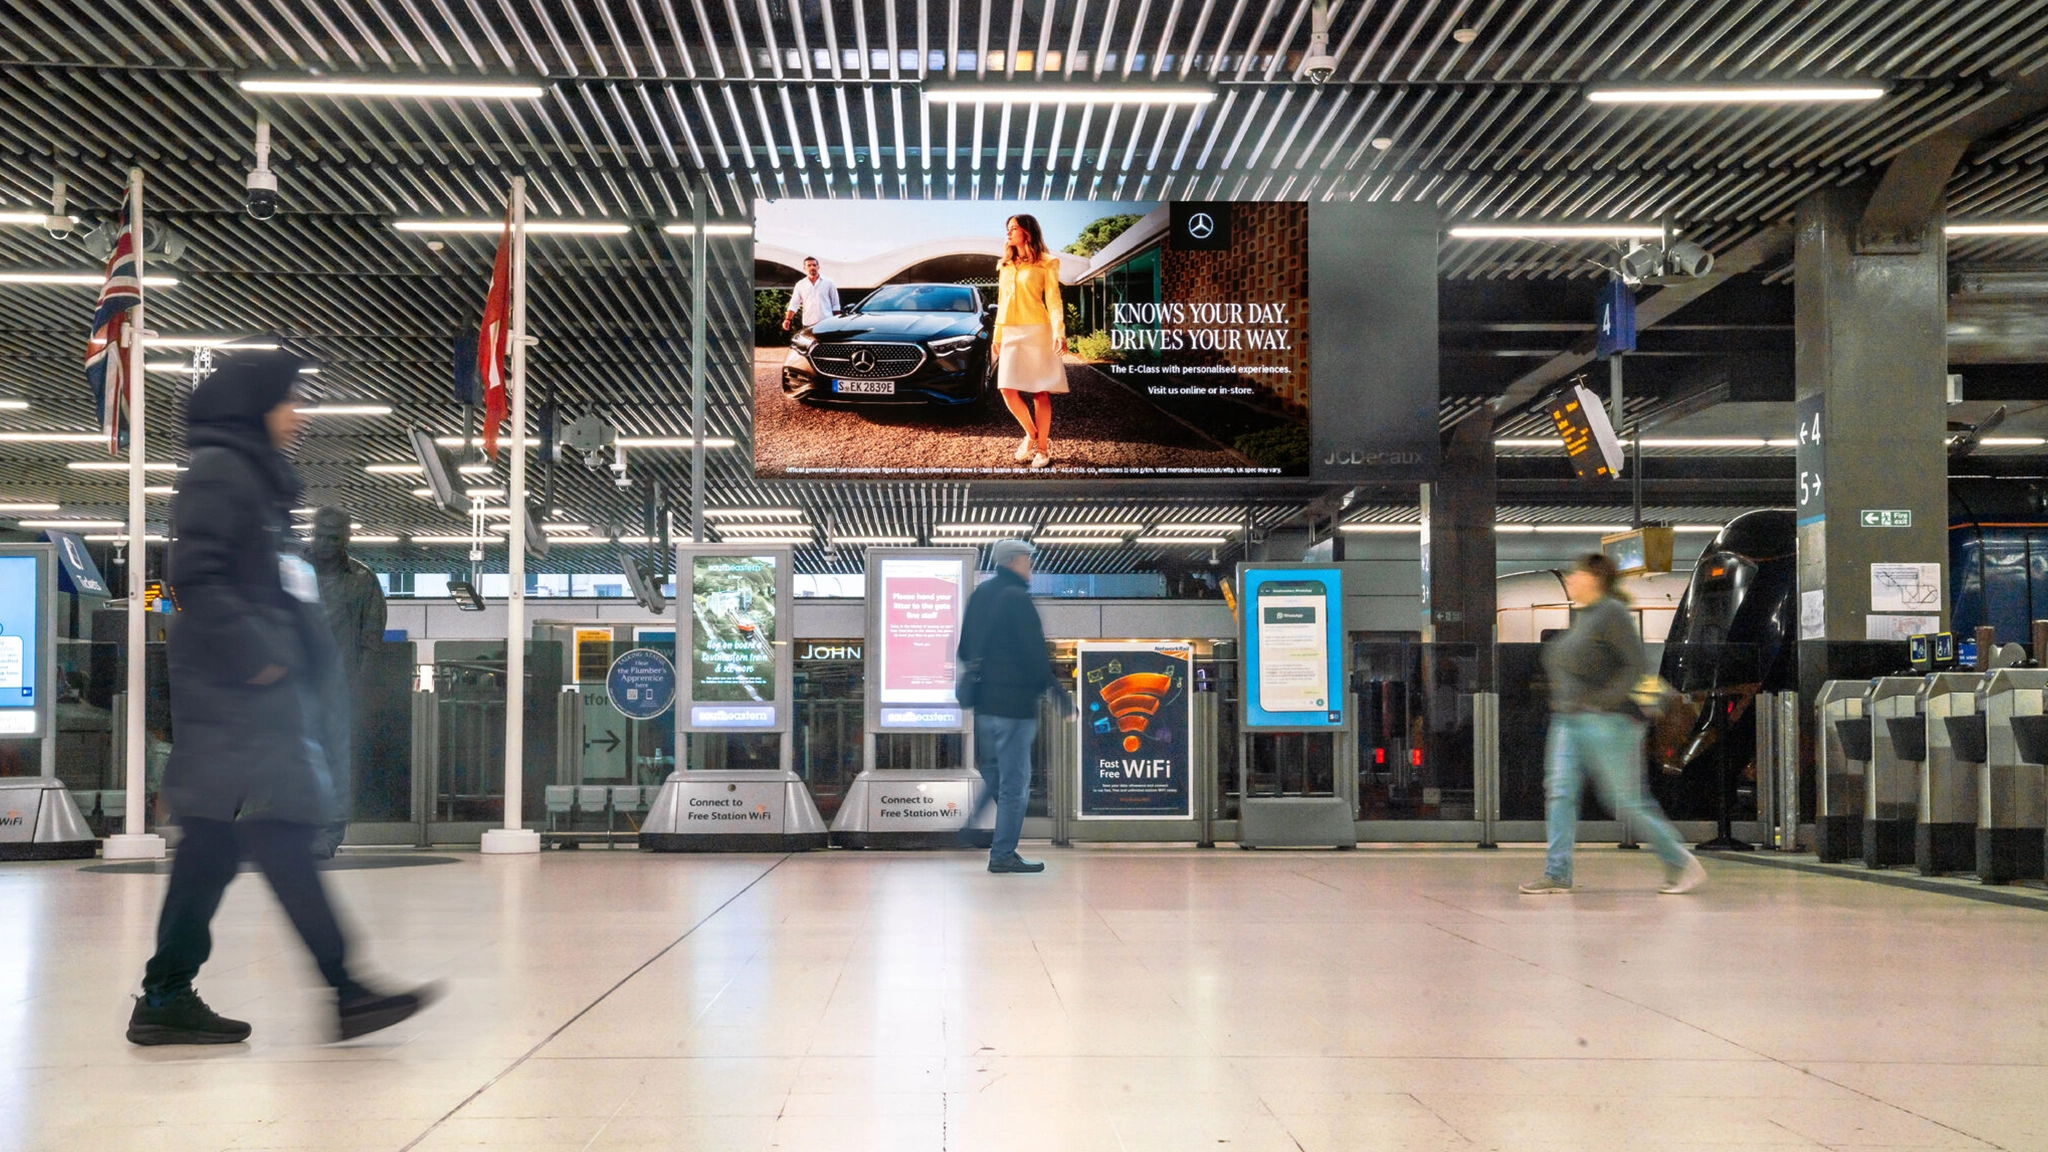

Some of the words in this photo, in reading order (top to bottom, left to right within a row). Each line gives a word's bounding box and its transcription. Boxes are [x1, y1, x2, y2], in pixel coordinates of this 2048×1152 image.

[1113, 302, 1185, 325] KNOWS
[1189, 302, 1244, 325] YOUR
[1248, 302, 1290, 325] DAY.
[1602, 303, 1611, 336] 4
[1110, 328, 1184, 351] DRIVES
[1188, 328, 1244, 351] YOUR
[1246, 328, 1292, 351] WAY.
[1110, 364, 1127, 374] The
[1128, 364, 1160, 374] E-Class
[1161, 364, 1181, 374] with
[1182, 364, 1236, 376] personalised
[1238, 365, 1292, 376] experiences.
[838, 382, 844, 391] S
[850, 382, 862, 392] EK
[864, 382, 892, 393] 2839E
[1148, 386, 1167, 395] Visit
[1180, 386, 1207, 395] online
[1219, 386, 1255, 395] in-store.
[1811, 412, 1821, 445] 4
[1324, 450, 1422, 465] JCDecaux
[1801, 471, 1809, 505] 5
[708, 564, 761, 572] southeastern
[707, 640, 721, 651] Hop
[734, 640, 756, 649] board
[750, 652, 768, 662] train
[801, 644, 861, 659] JOHN
[618, 652, 642, 665] TALKING
[621, 674, 664, 683] Apprentice
[698, 711, 768, 721] southeastern
[888, 711, 955, 723] southeastern
[1100, 759, 1119, 768] Fast
[1122, 759, 1170, 778] WiFi
[1100, 769, 1120, 778] Free
[689, 798, 729, 807] Connect
[881, 796, 920, 804] Connect
[688, 812, 709, 820] Free
[712, 812, 747, 820] Station
[748, 812, 771, 820] WiFi
[880, 809, 901, 817] Free
[903, 809, 938, 817] Station
